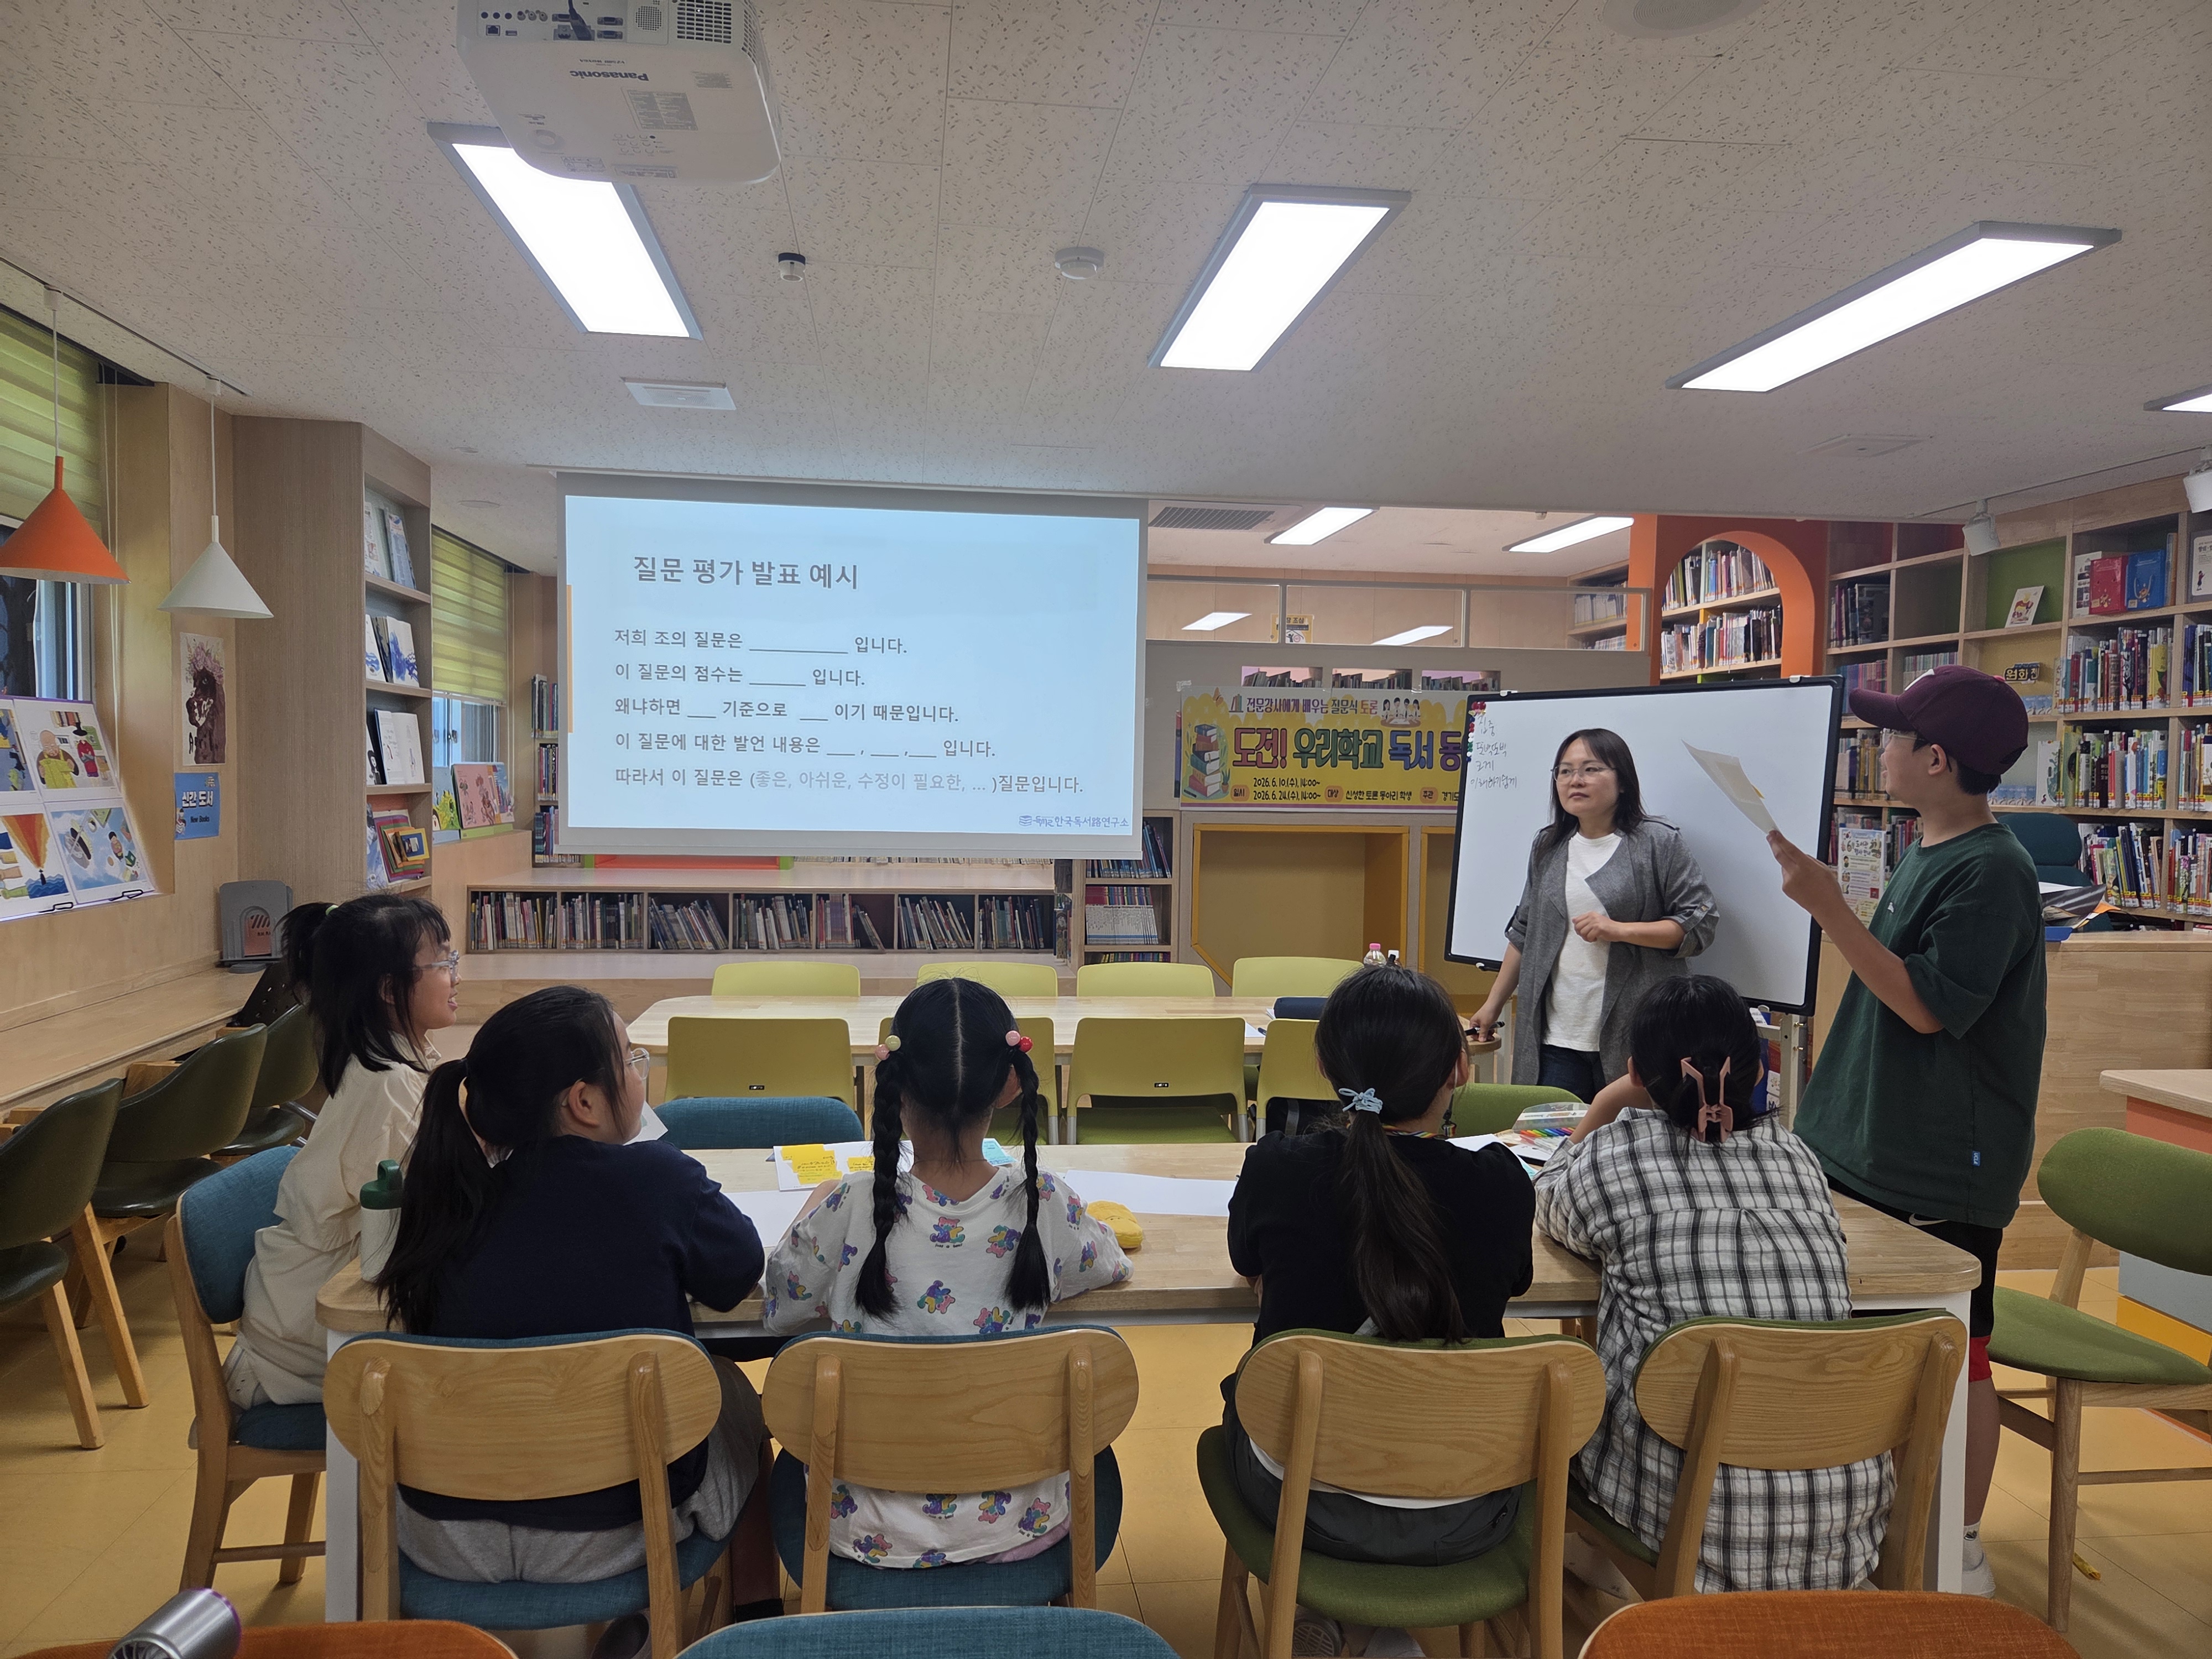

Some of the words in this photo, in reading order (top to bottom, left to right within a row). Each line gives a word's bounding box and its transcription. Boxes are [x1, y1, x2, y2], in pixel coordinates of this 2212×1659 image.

[570, 70, 649, 81] Panasonic
[634, 557, 684, 582] 질문
[693, 560, 743, 585] 평가
[752, 561, 801, 586] 발표
[810, 564, 857, 589] 예시
[615, 629, 646, 646] 저희
[655, 631, 685, 648] 조의
[695, 632, 743, 648] 질문은
[855, 637, 907, 654] 입니다.
[616, 664, 629, 680] 이
[639, 664, 685, 681] 질문의
[695, 666, 743, 682] 점수는
[813, 669, 864, 686] 입니다.
[615, 698, 680, 715] 왜냐하면
[723, 701, 787, 717] 기준으로
[835, 704, 864, 721] 이기
[874, 705, 958, 723] 때문입니다.
[1246, 697, 1300, 713] 전문강사에게
[1302, 698, 1328, 713] 배우는
[1331, 699, 1358, 714] 질문식
[1360, 700, 1378, 714] 토론
[616, 733, 629, 749] 이
[639, 733, 686, 750] 질문에
[695, 734, 726, 751] 대한
[734, 735, 764, 752] 발언
[774, 737, 820, 753] 내용은
[944, 740, 995, 757] 입니다.
[1293, 728, 1384, 769] 우리학교
[1389, 730, 1434, 770] 독서
[616, 768, 663, 786] 따라서
[672, 769, 685, 785] 이
[695, 769, 743, 786] 질문은
[750, 771, 791, 789] (좋은,
[800, 771, 851, 790] 아쉬운,
[858, 773, 905, 790] 수정이
[914, 774, 964, 792] 필요한,
[992, 775, 1083, 793] )질문입니다.
[1254, 778, 1270, 787] 2026.
[1272, 778, 1277, 787] 6.
[1300, 778, 1321, 787] 14:00~
[182, 791, 197, 807] 신간
[199, 791, 213, 807] 도서
[1233, 789, 1244, 797] 일시
[1254, 791, 1270, 800] 2026.
[1272, 791, 1277, 800] 6.
[1301, 791, 1321, 801] 14:00~
[1327, 789, 1339, 798] 대상
[1366, 791, 1378, 800] 토론
[1380, 791, 1398, 800] 동아리
[1400, 791, 1412, 801] 학생
